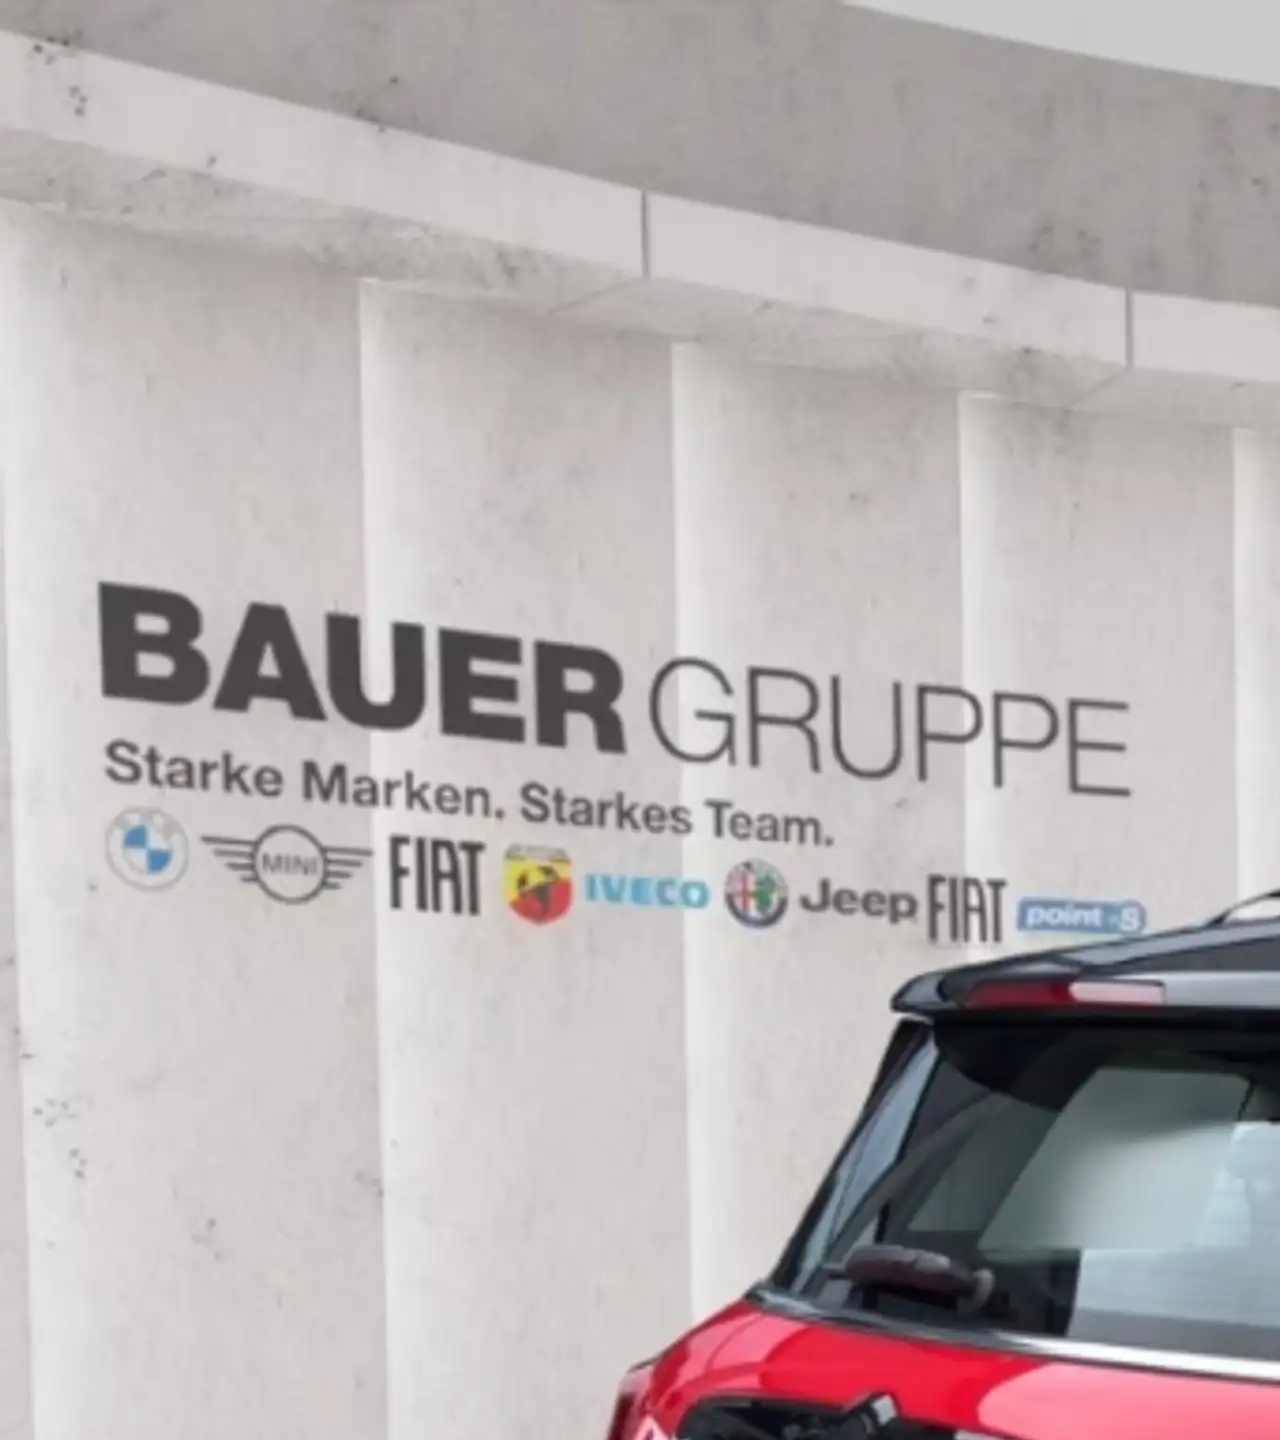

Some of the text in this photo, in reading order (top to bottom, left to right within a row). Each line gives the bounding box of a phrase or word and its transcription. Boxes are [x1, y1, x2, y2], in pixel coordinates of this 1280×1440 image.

[98, 579, 1133, 798] BAUER GRUPPE
[104, 738, 836, 848] Starke Marken. Starkes Team.
[260, 851, 321, 879] MINI
[388, 833, 487, 917] FIAT
[584, 872, 710, 910] IVECO
[799, 876, 919, 926] Jeep
[926, 872, 1008, 944] FIAT
